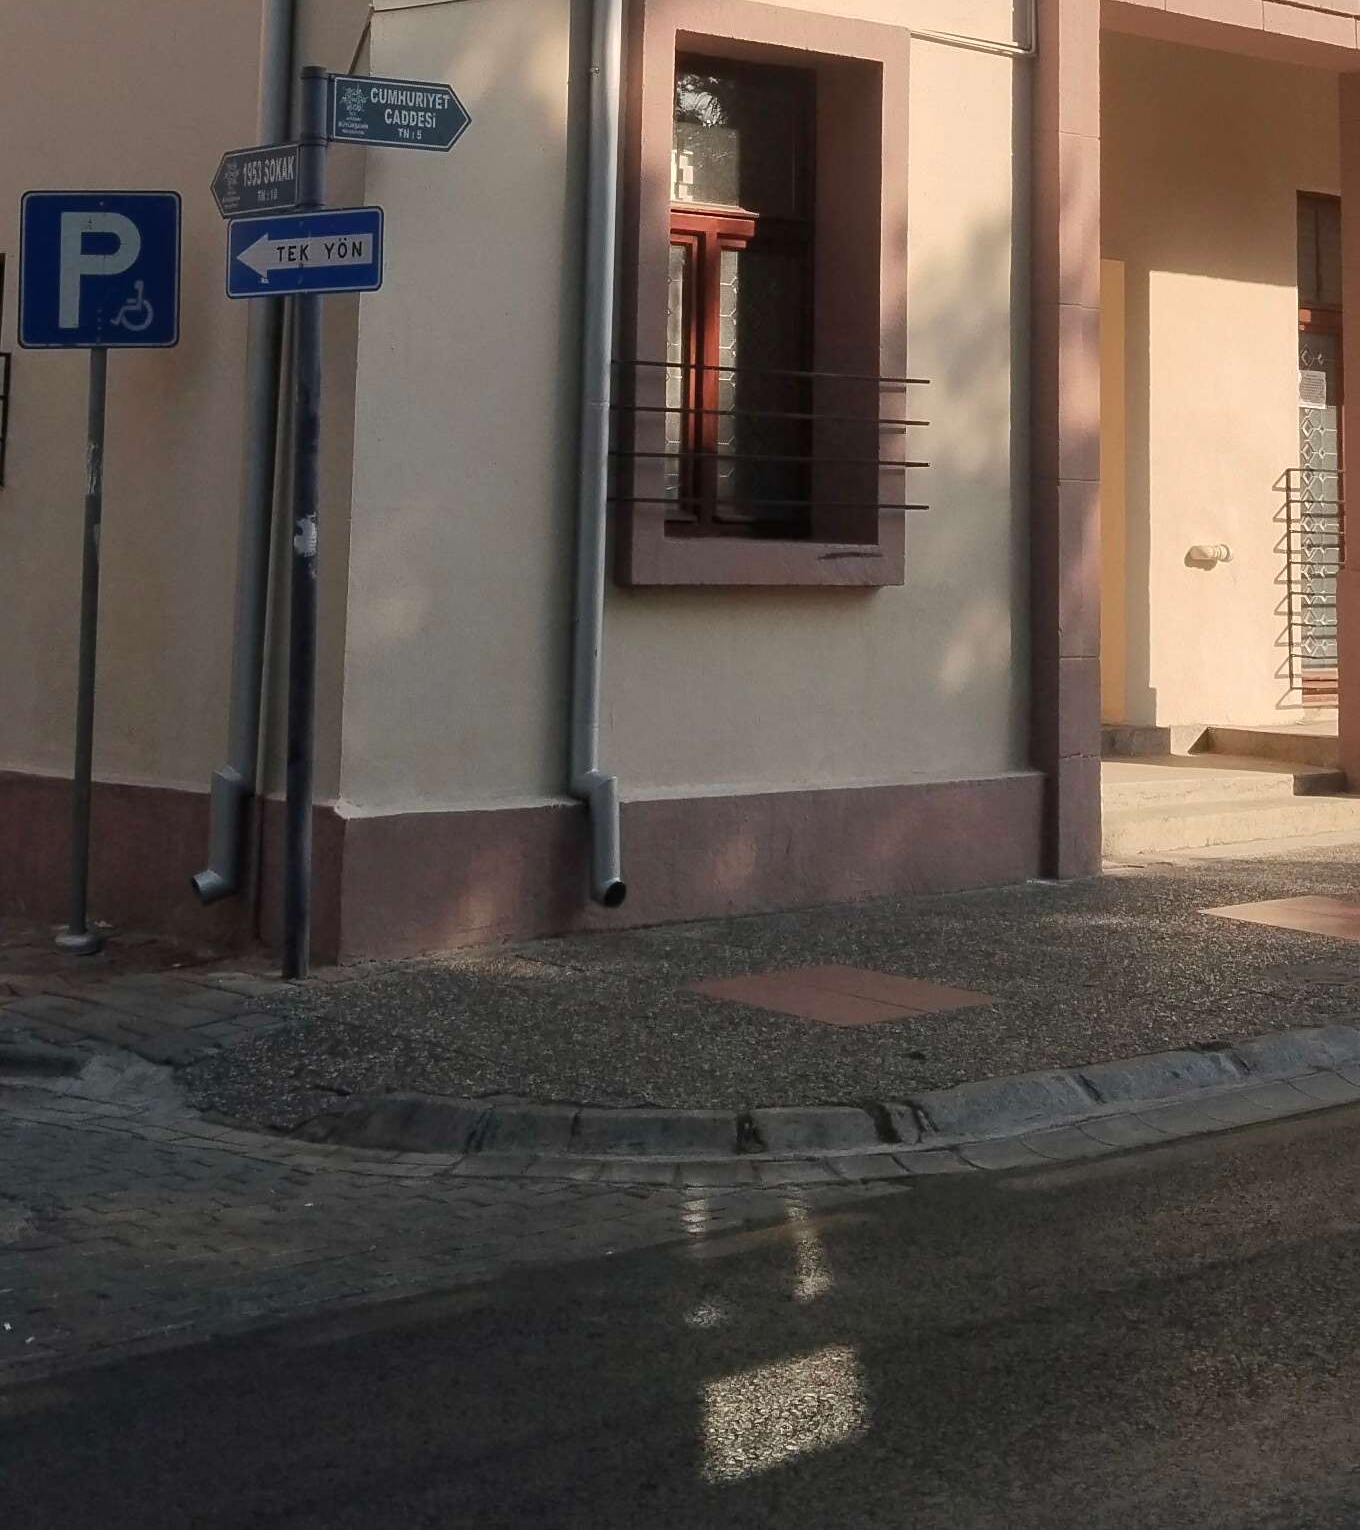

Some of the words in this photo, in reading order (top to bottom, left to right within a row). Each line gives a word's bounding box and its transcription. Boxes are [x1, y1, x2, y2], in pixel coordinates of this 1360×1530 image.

[243, 160, 262, 188] 1953
[264, 155, 295, 184] SOKAK
[276, 244, 309, 263] TEK
[323, 237, 363, 260] YÖN
[58, 211, 142, 329] P
